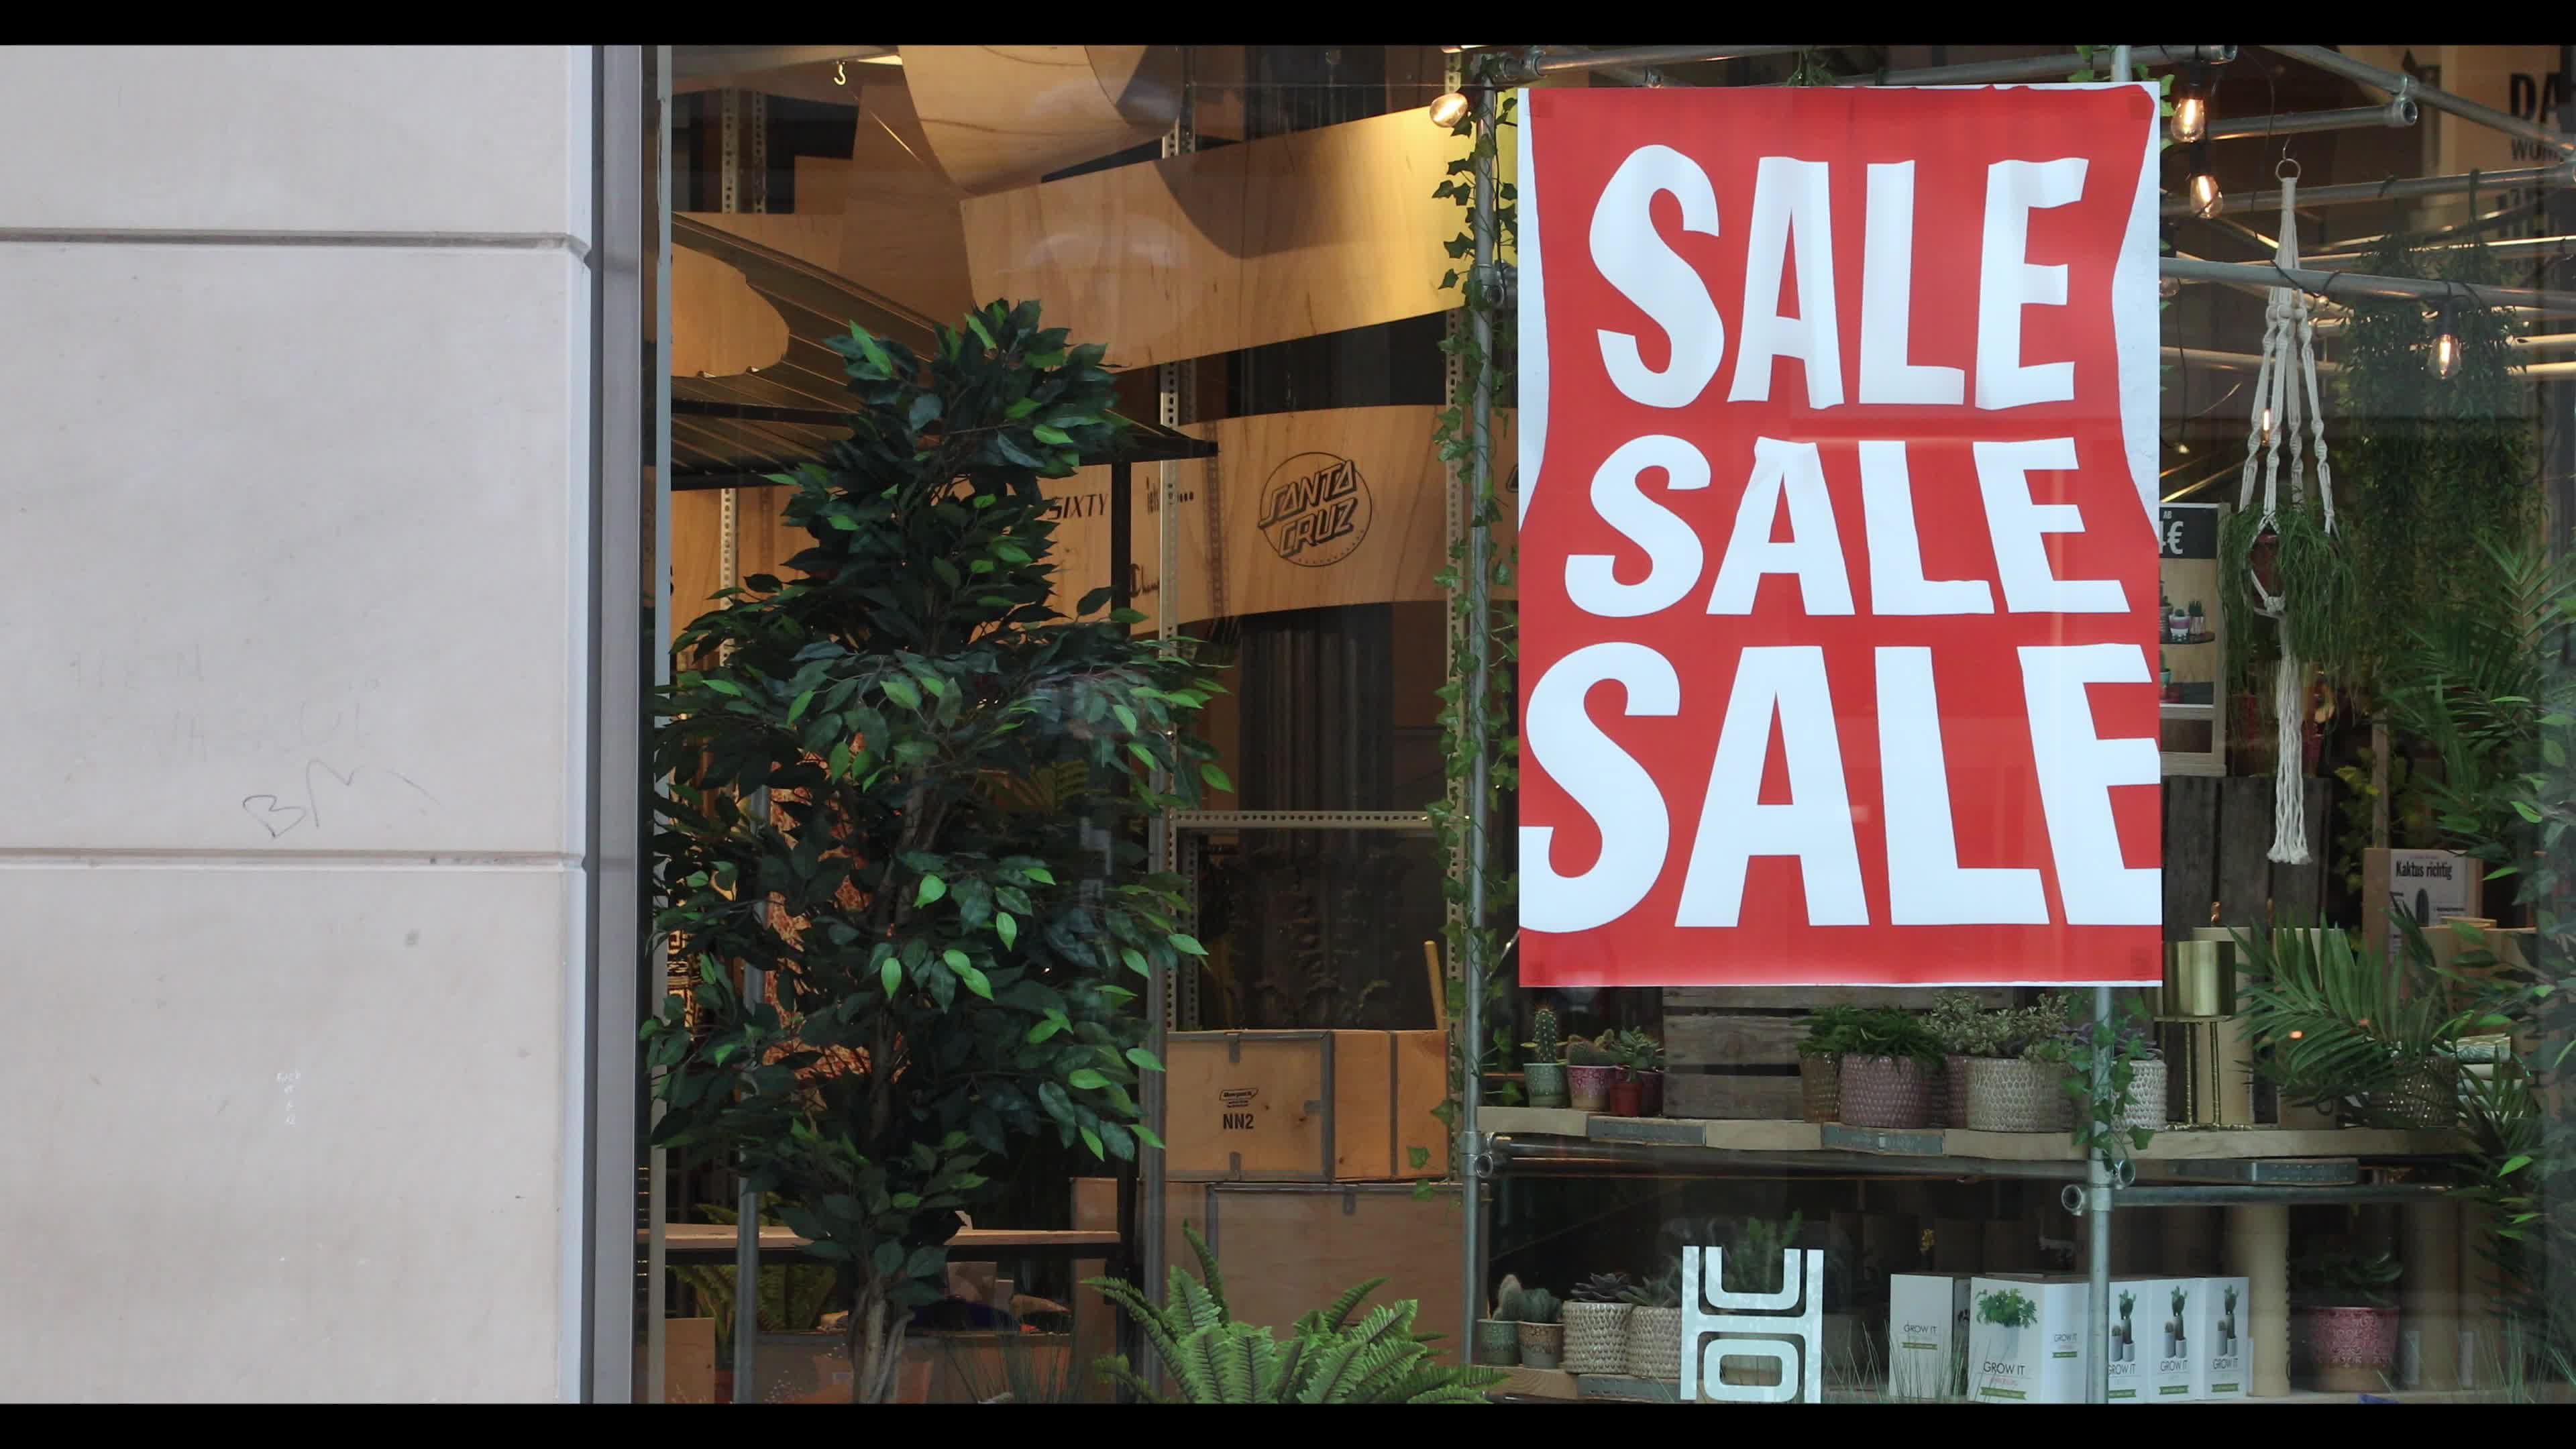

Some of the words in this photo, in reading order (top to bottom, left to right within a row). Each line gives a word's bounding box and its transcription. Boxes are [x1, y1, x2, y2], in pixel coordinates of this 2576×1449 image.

[1589, 144, 2089, 410] SALE
[1258, 460, 1356, 530] SANTA
[2163, 511, 2172, 519] AB
[1279, 497, 1358, 558] CRUZ
[1564, 434, 2131, 616] SALE
[1519, 641, 2162, 932] SALE
[2396, 861, 2424, 877] Kaktus
[2426, 861, 2453, 880] richtig
[1224, 1114, 1254, 1129] NN2
[1904, 1325, 1929, 1333] GROW
[1931, 1326, 1937, 1334] IT
[1983, 1361, 2015, 1375] GROW
[2017, 1364, 2025, 1375] IT
[2160, 1360, 2180, 1372] GROW
[2212, 1358, 2232, 1369] GROW
